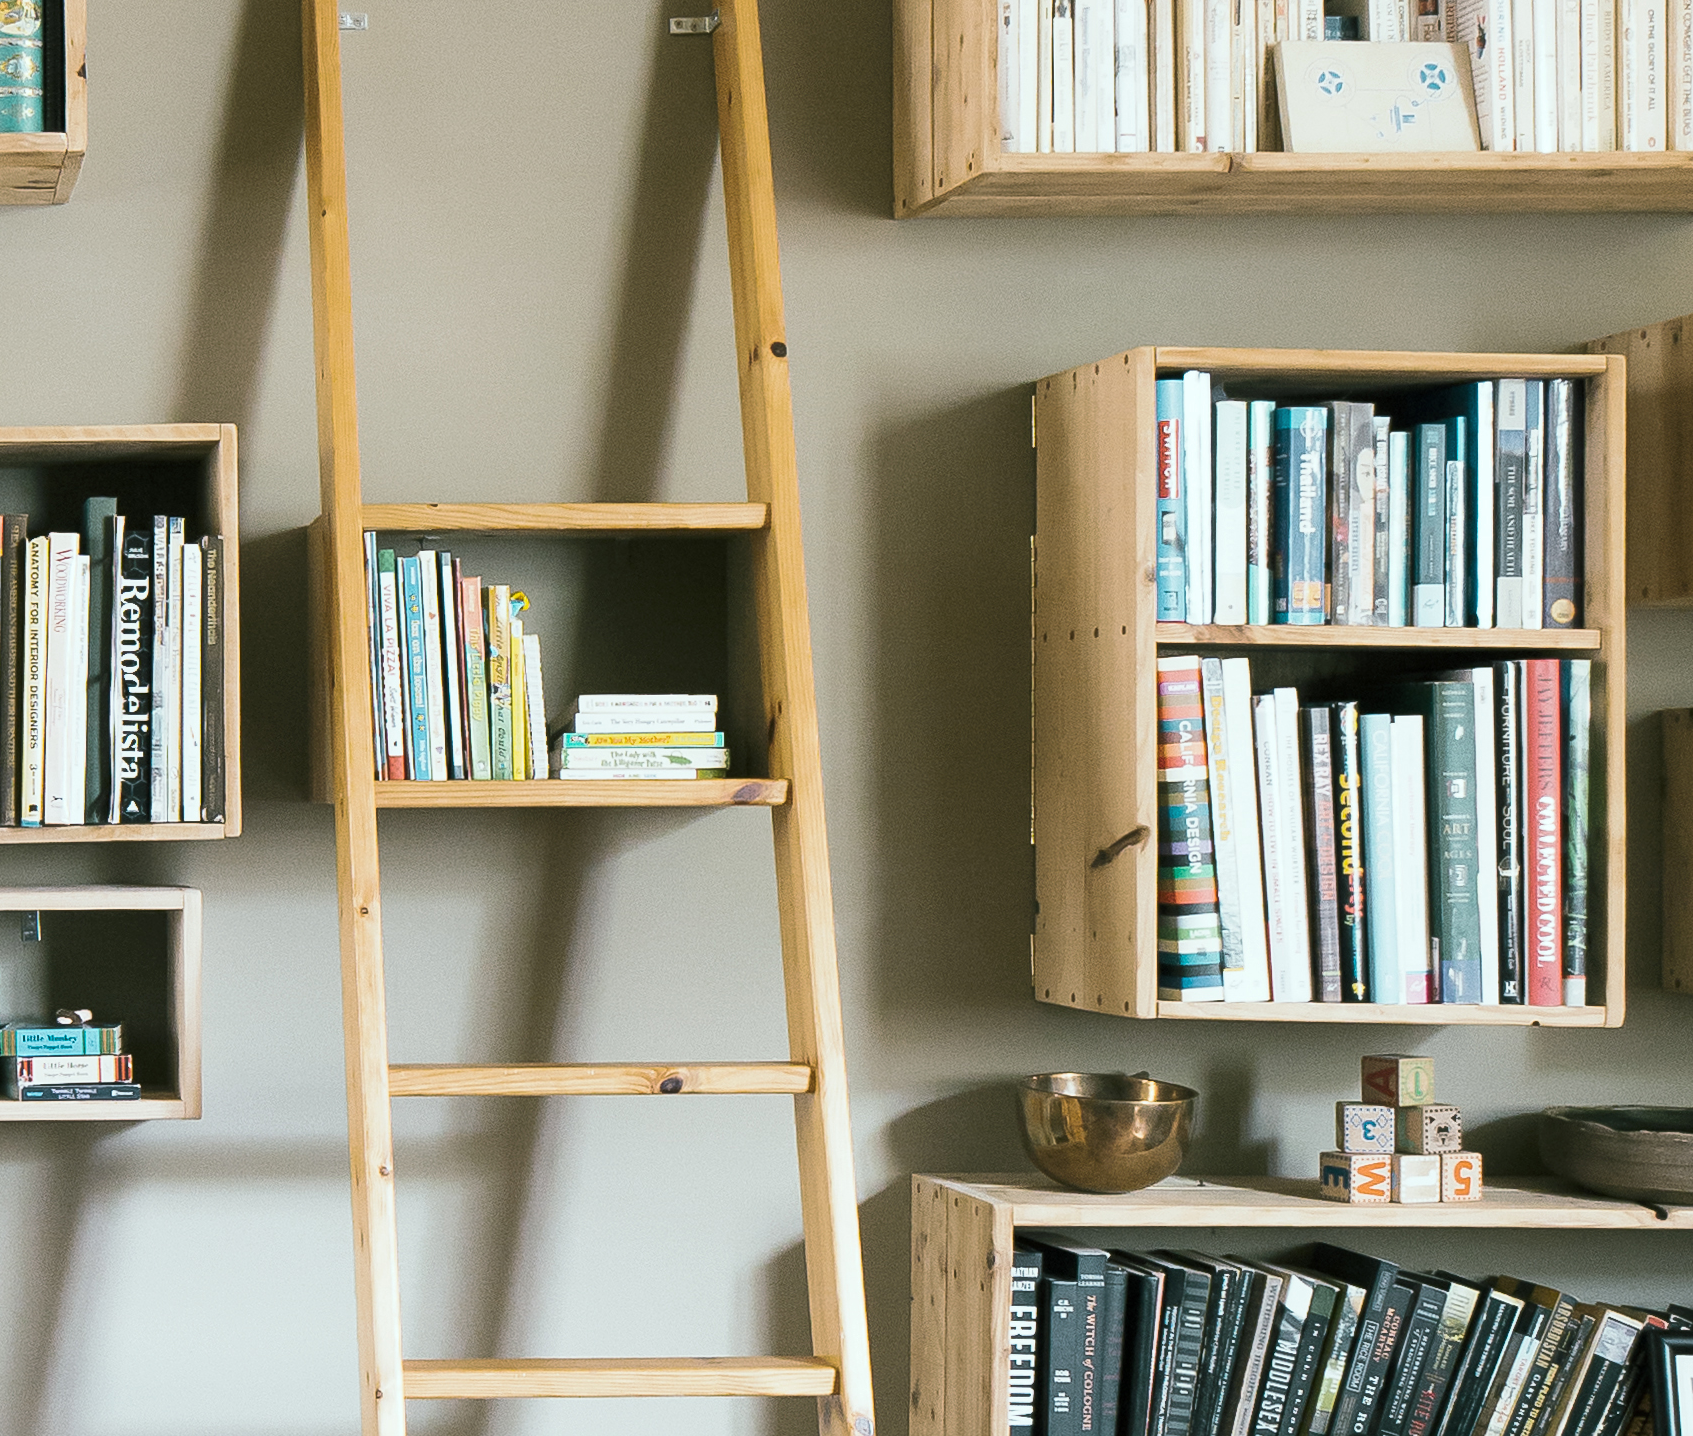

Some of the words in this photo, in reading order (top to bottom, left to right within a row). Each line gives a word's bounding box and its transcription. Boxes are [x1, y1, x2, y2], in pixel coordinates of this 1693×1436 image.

[1682, 12, 1692, 63] COWGIRLS
[1497, 47, 1507, 100] HOLLAND
[1682, 65, 1692, 83] GET
[1683, 86, 1692, 106] THE
[1683, 109, 1692, 136] BLUES
[1299, 451, 1318, 533] Thailand
[30, 542, 40, 597] ANATOMY
[207, 549, 218, 568] The
[30, 602, 39, 624] FOR
[54, 548, 73, 633] WOODWORKING
[383, 584, 393, 612] VIVA
[384, 618, 394, 633] LA
[470, 627, 480, 648] This
[30, 629, 40, 680] INTERIOR
[386, 638, 396, 676] PIZZA!
[120, 576, 149, 782] Remodelista
[1537, 673, 1552, 705] JAY
[29, 685, 39, 749] DESIGNERS
[472, 690, 484, 721] Piggy
[1210, 696, 1225, 755] Design
[1179, 721, 1199, 813] CALIFRNIA
[1263, 741, 1274, 787] CONRAN
[1314, 734, 1329, 765] REX
[1538, 710, 1552, 790] JEFFERS
[1215, 759, 1231, 842] Research
[1315, 768, 1331, 796] RAY
[1317, 800, 1332, 828] ART
[1185, 817, 1202, 873] DESIGN
[1536, 795, 1556, 912] COLLECTED
[1319, 846, 1335, 901] DESIGN
[1537, 913, 1556, 968] COOL
[22, 1034, 45, 1043] Little
[47, 1034, 77, 1044] Monkey
[1086, 1295, 1097, 1312] The
[1084, 1313, 1096, 1356] WITCH
[1383, 1316, 1400, 1360] CORMAC
[1535, 1301, 1573, 1368] ABSURDISTAN
[1008, 1305, 1038, 1427] FREEDOM
[1082, 1359, 1094, 1368] of
[1264, 1339, 1297, 1434] MIDDLESEX
[1528, 1373, 1541, 1400] GARY
[1082, 1371, 1094, 1431] COLOGNE
